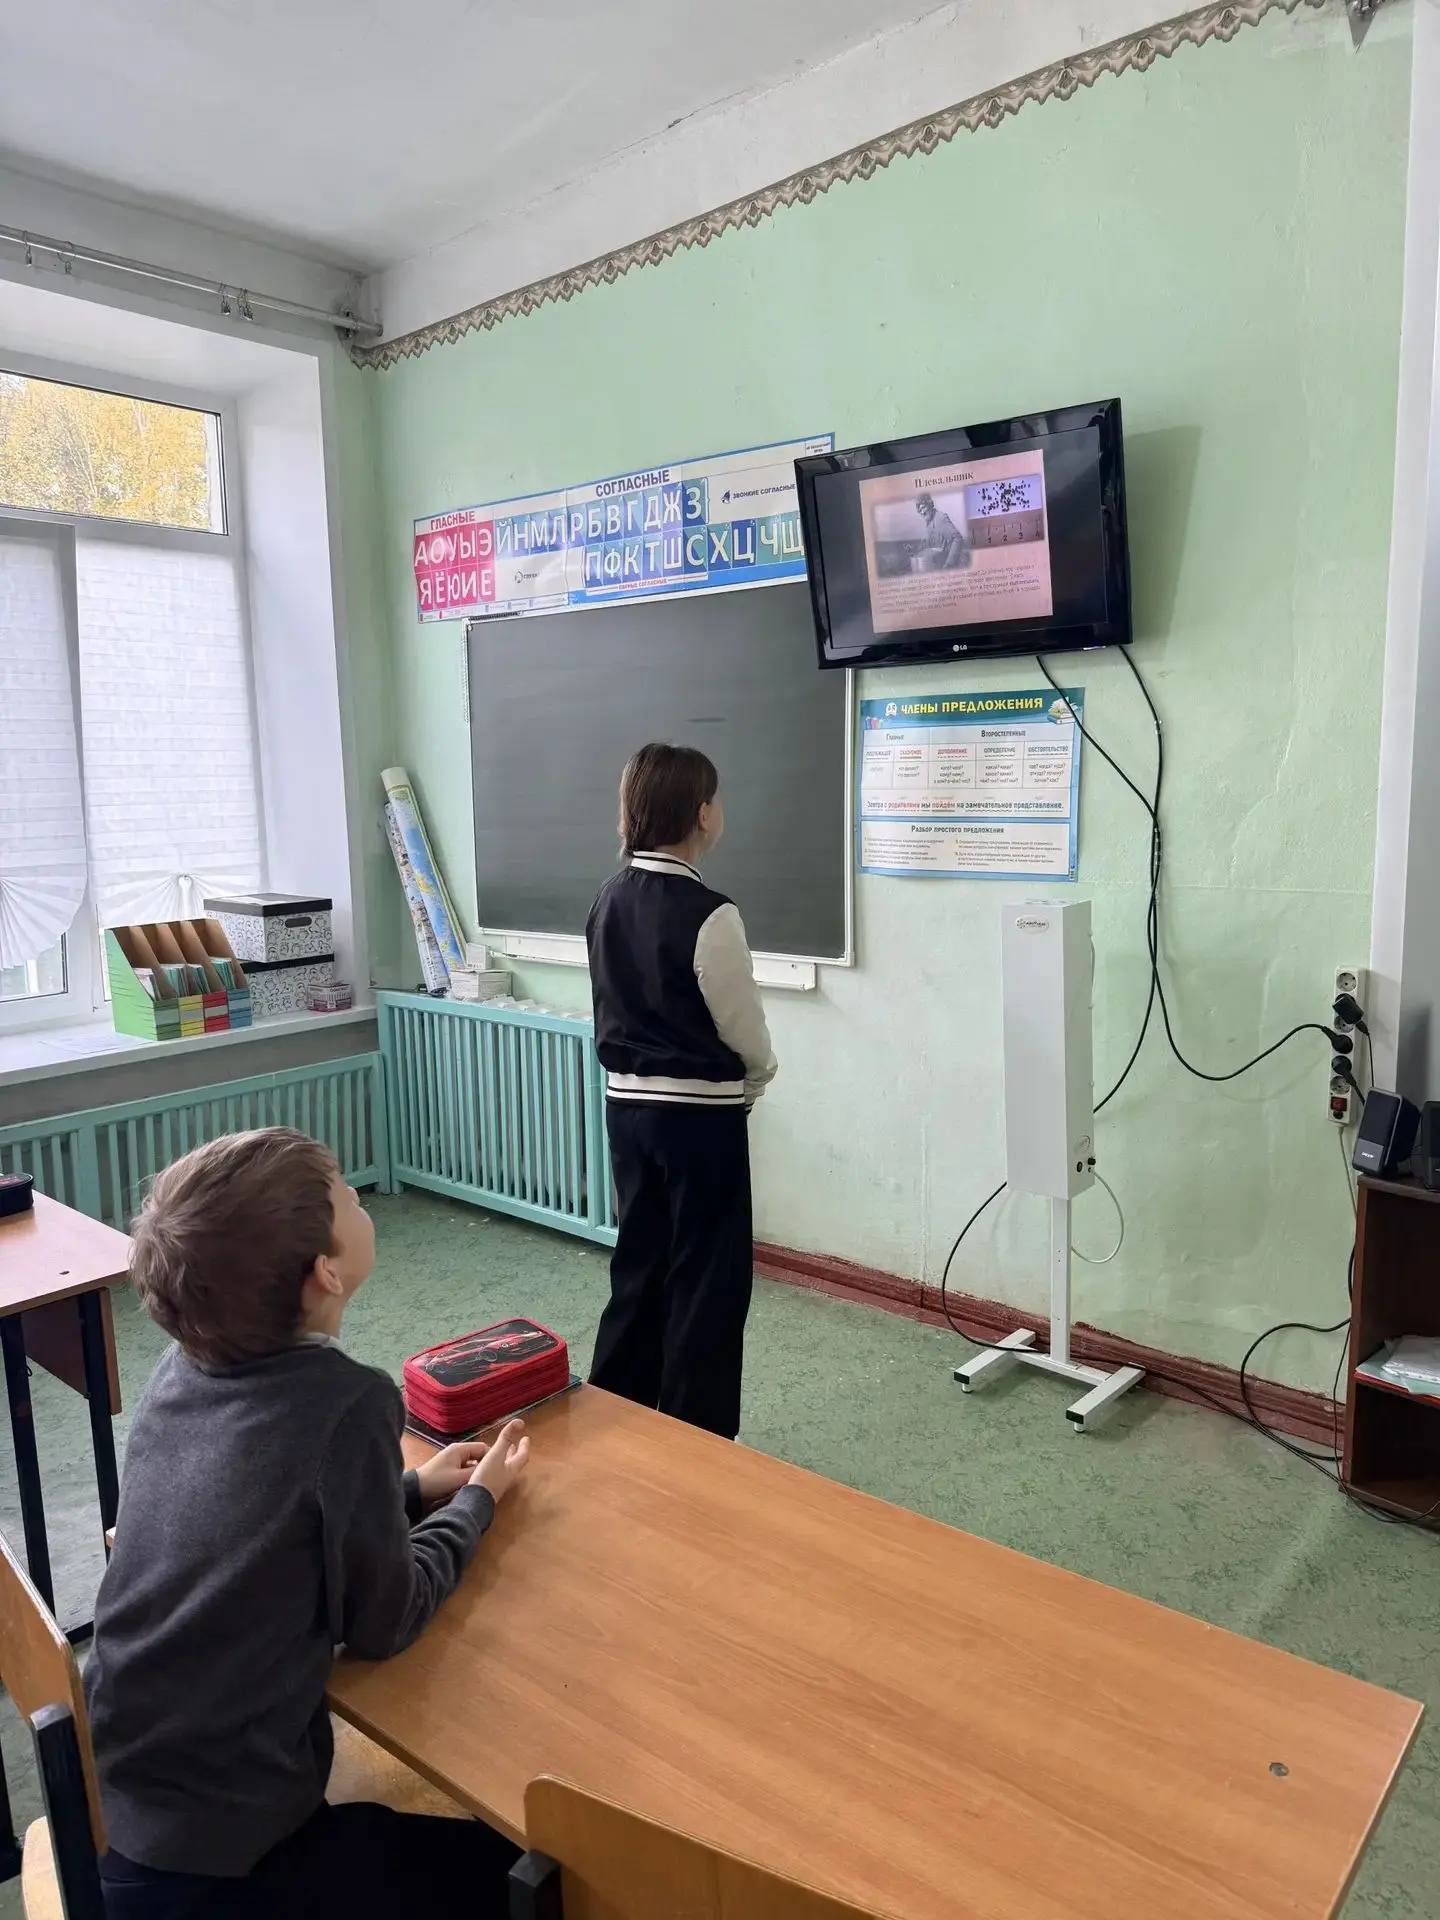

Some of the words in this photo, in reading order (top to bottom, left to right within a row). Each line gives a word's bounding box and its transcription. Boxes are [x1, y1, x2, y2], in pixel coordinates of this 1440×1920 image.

[596, 470, 670, 497] СОГЛАСНЫЕ
[733, 489, 759, 499] ЗВОНКИЕ
[760, 484, 795, 494] СОГЛАСНЫЕ
[430, 511, 475, 530] ГЛАСНЫЕ
[901, 703, 938, 714] ЧЛЕНЫ
[942, 698, 1043, 713] ПРЕДЛОЖЕНИЯ
